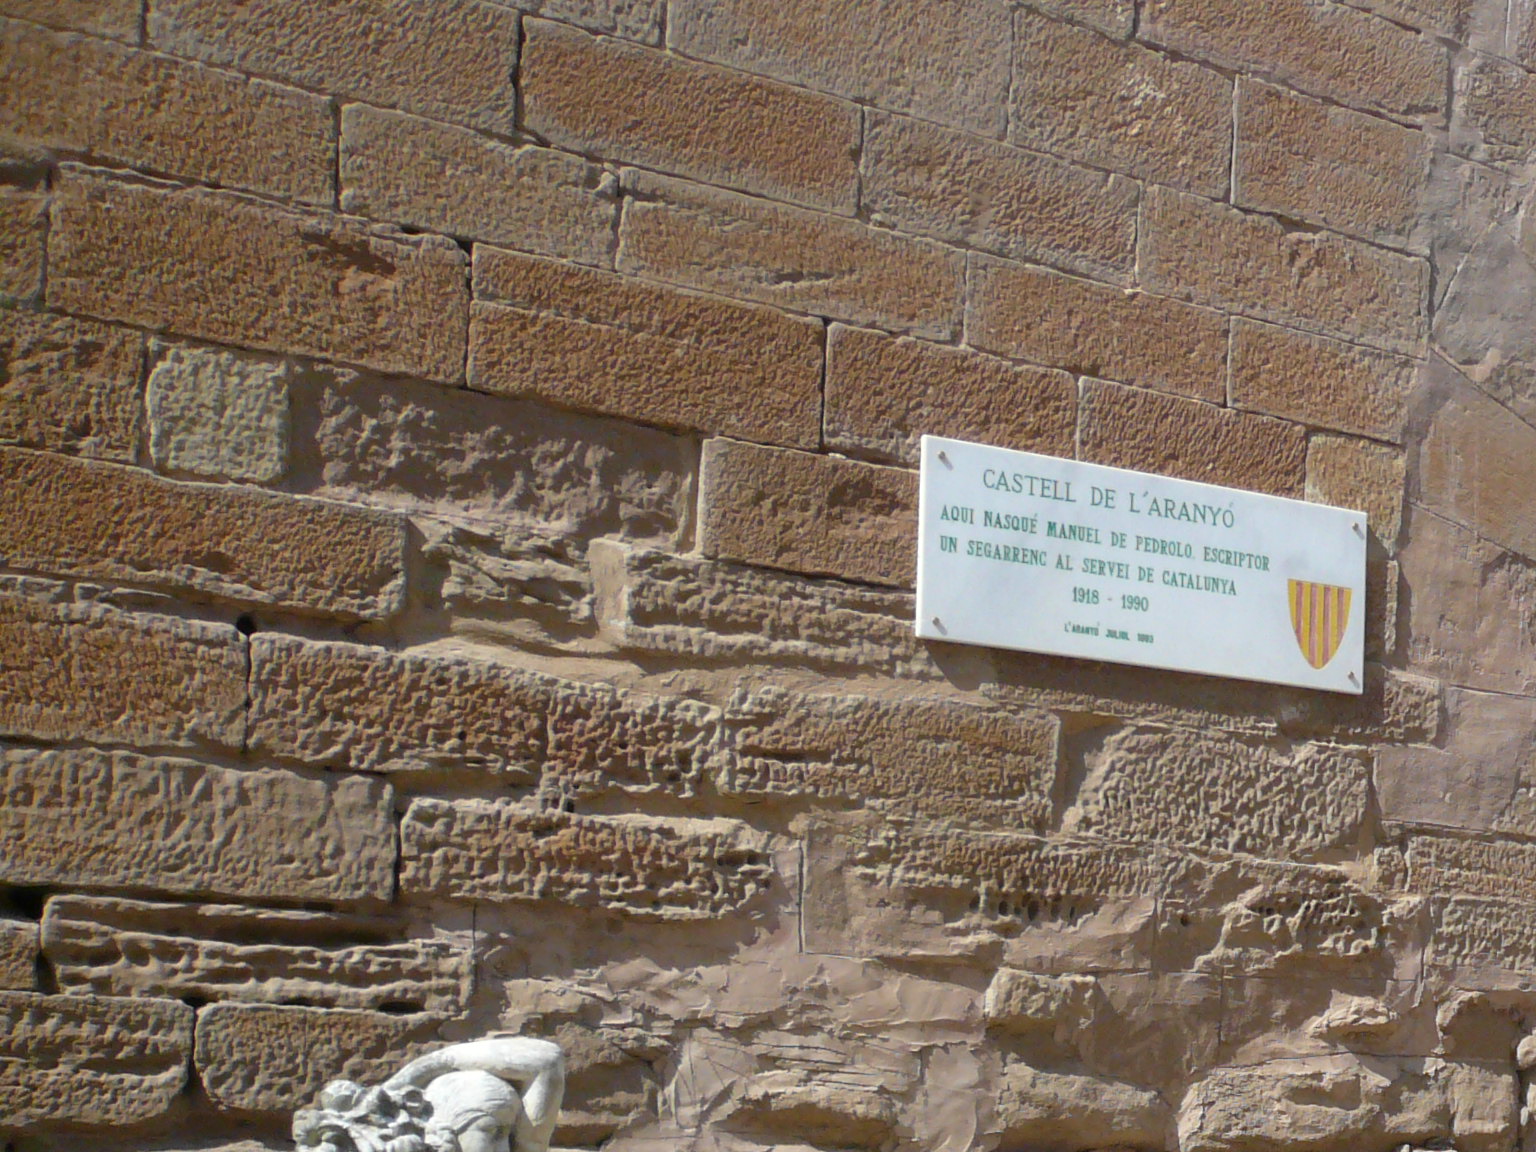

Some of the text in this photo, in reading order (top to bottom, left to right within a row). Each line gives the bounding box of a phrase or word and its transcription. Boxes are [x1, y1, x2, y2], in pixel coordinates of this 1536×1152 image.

[983, 469, 1076, 503] CASTELL
[1090, 486, 1116, 509] DE
[940, 505, 975, 525] AQUI
[983, 510, 1038, 534] NASQUÉ
[1046, 521, 1102, 544] MANUEL
[1111, 531, 1127, 548] DE
[1203, 546, 1270, 572] ESCRIPTOR
[940, 535, 1237, 596] UN SEGARRENC AL SERVEI DE CATALUNYA
[1072, 586, 1100, 605] 1918
[1121, 594, 1149, 612] 1990
